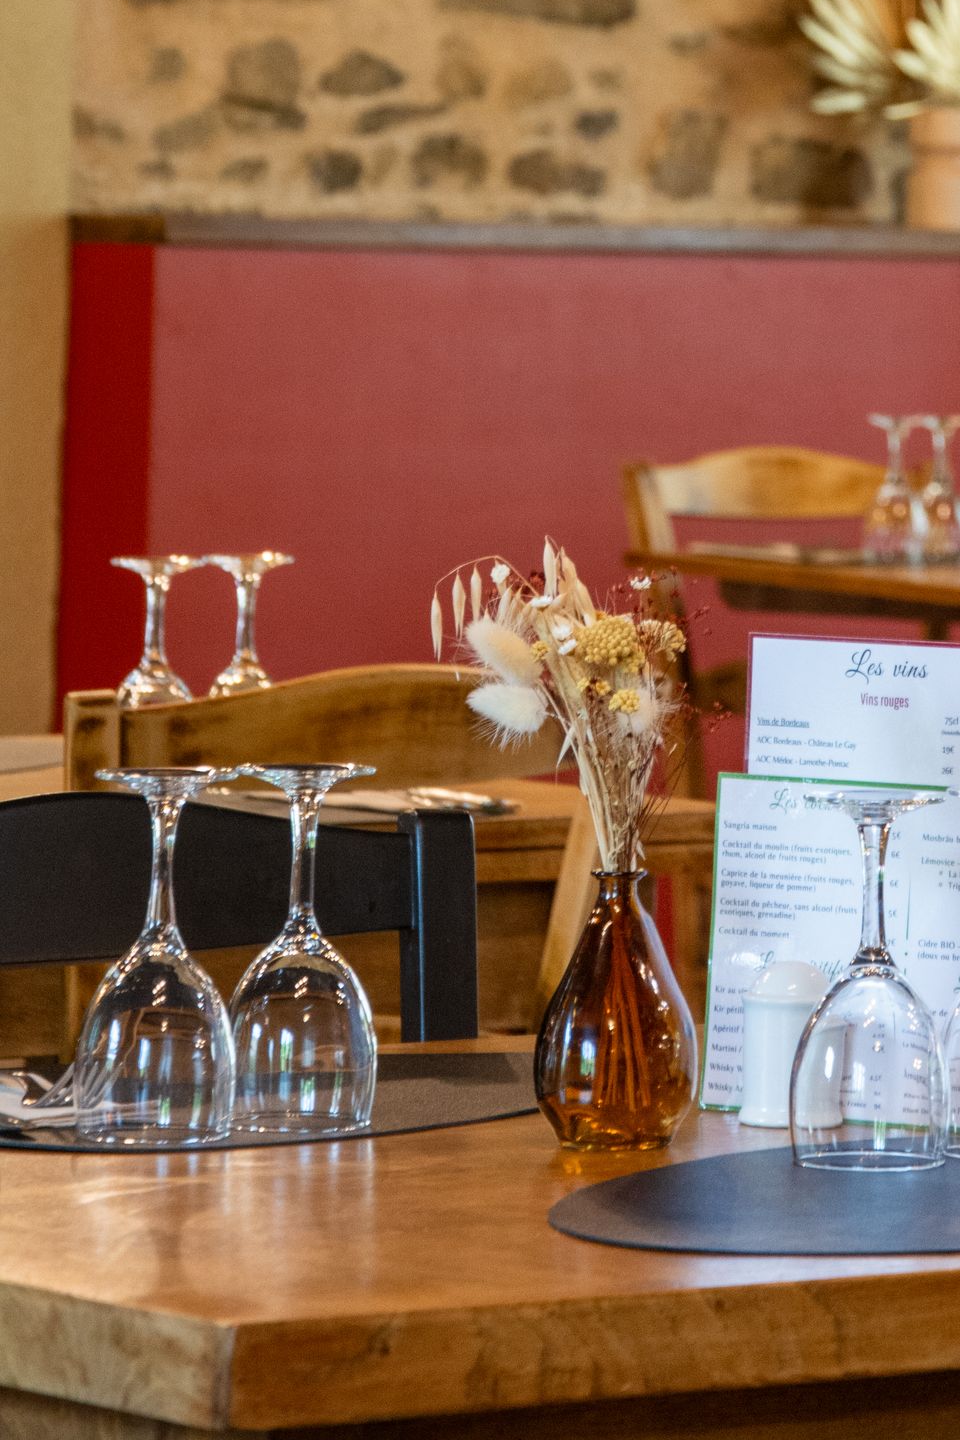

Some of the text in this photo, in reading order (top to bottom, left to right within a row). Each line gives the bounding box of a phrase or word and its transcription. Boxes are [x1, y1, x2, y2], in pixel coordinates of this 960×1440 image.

[845, 648, 928, 685] Les vins
[860, 692, 910, 711] Vins rouges
[757, 717, 810, 729] Vins de Bordeaux
[944, 717, 959, 727] 75cl
[757, 736, 856, 752] AOC Bordeaux Château Le Gay
[756, 754, 772, 764] AOC
[770, 788, 798, 815] Les
[723, 821, 777, 832] Sangria maison
[722, 839, 852, 858] Cocktail du moulin (fruits exotiques,
[722, 850, 827, 865] rhum, alcool de fruits rouges)
[921, 856, 955, 868] Lémovice
[721, 868, 854, 887] Caprice de la meunière (fruits rouges,
[949, 871, 957, 880] La
[720, 880, 817, 894] goyave, liqueur de pomme)
[719, 897, 857, 915] Cocktail du pêcheur, sans alcool (fruits
[719, 909, 796, 922] exotiques, grenadine)
[718, 926, 790, 939] Cocktail du moment
[918, 939, 938, 950] Cidre
[941, 941, 955, 951] BIO
[917, 951, 938, 961] (doux
[940, 953, 950, 962] ou
[715, 984, 725, 994] Kir
[714, 1004, 724, 1014] Kir
[713, 1023, 740, 1034] Apéritif
[712, 1042, 737, 1054] Martini
[710, 1062, 734, 1075] Whisky
[708, 1081, 732, 1095] Whisky
